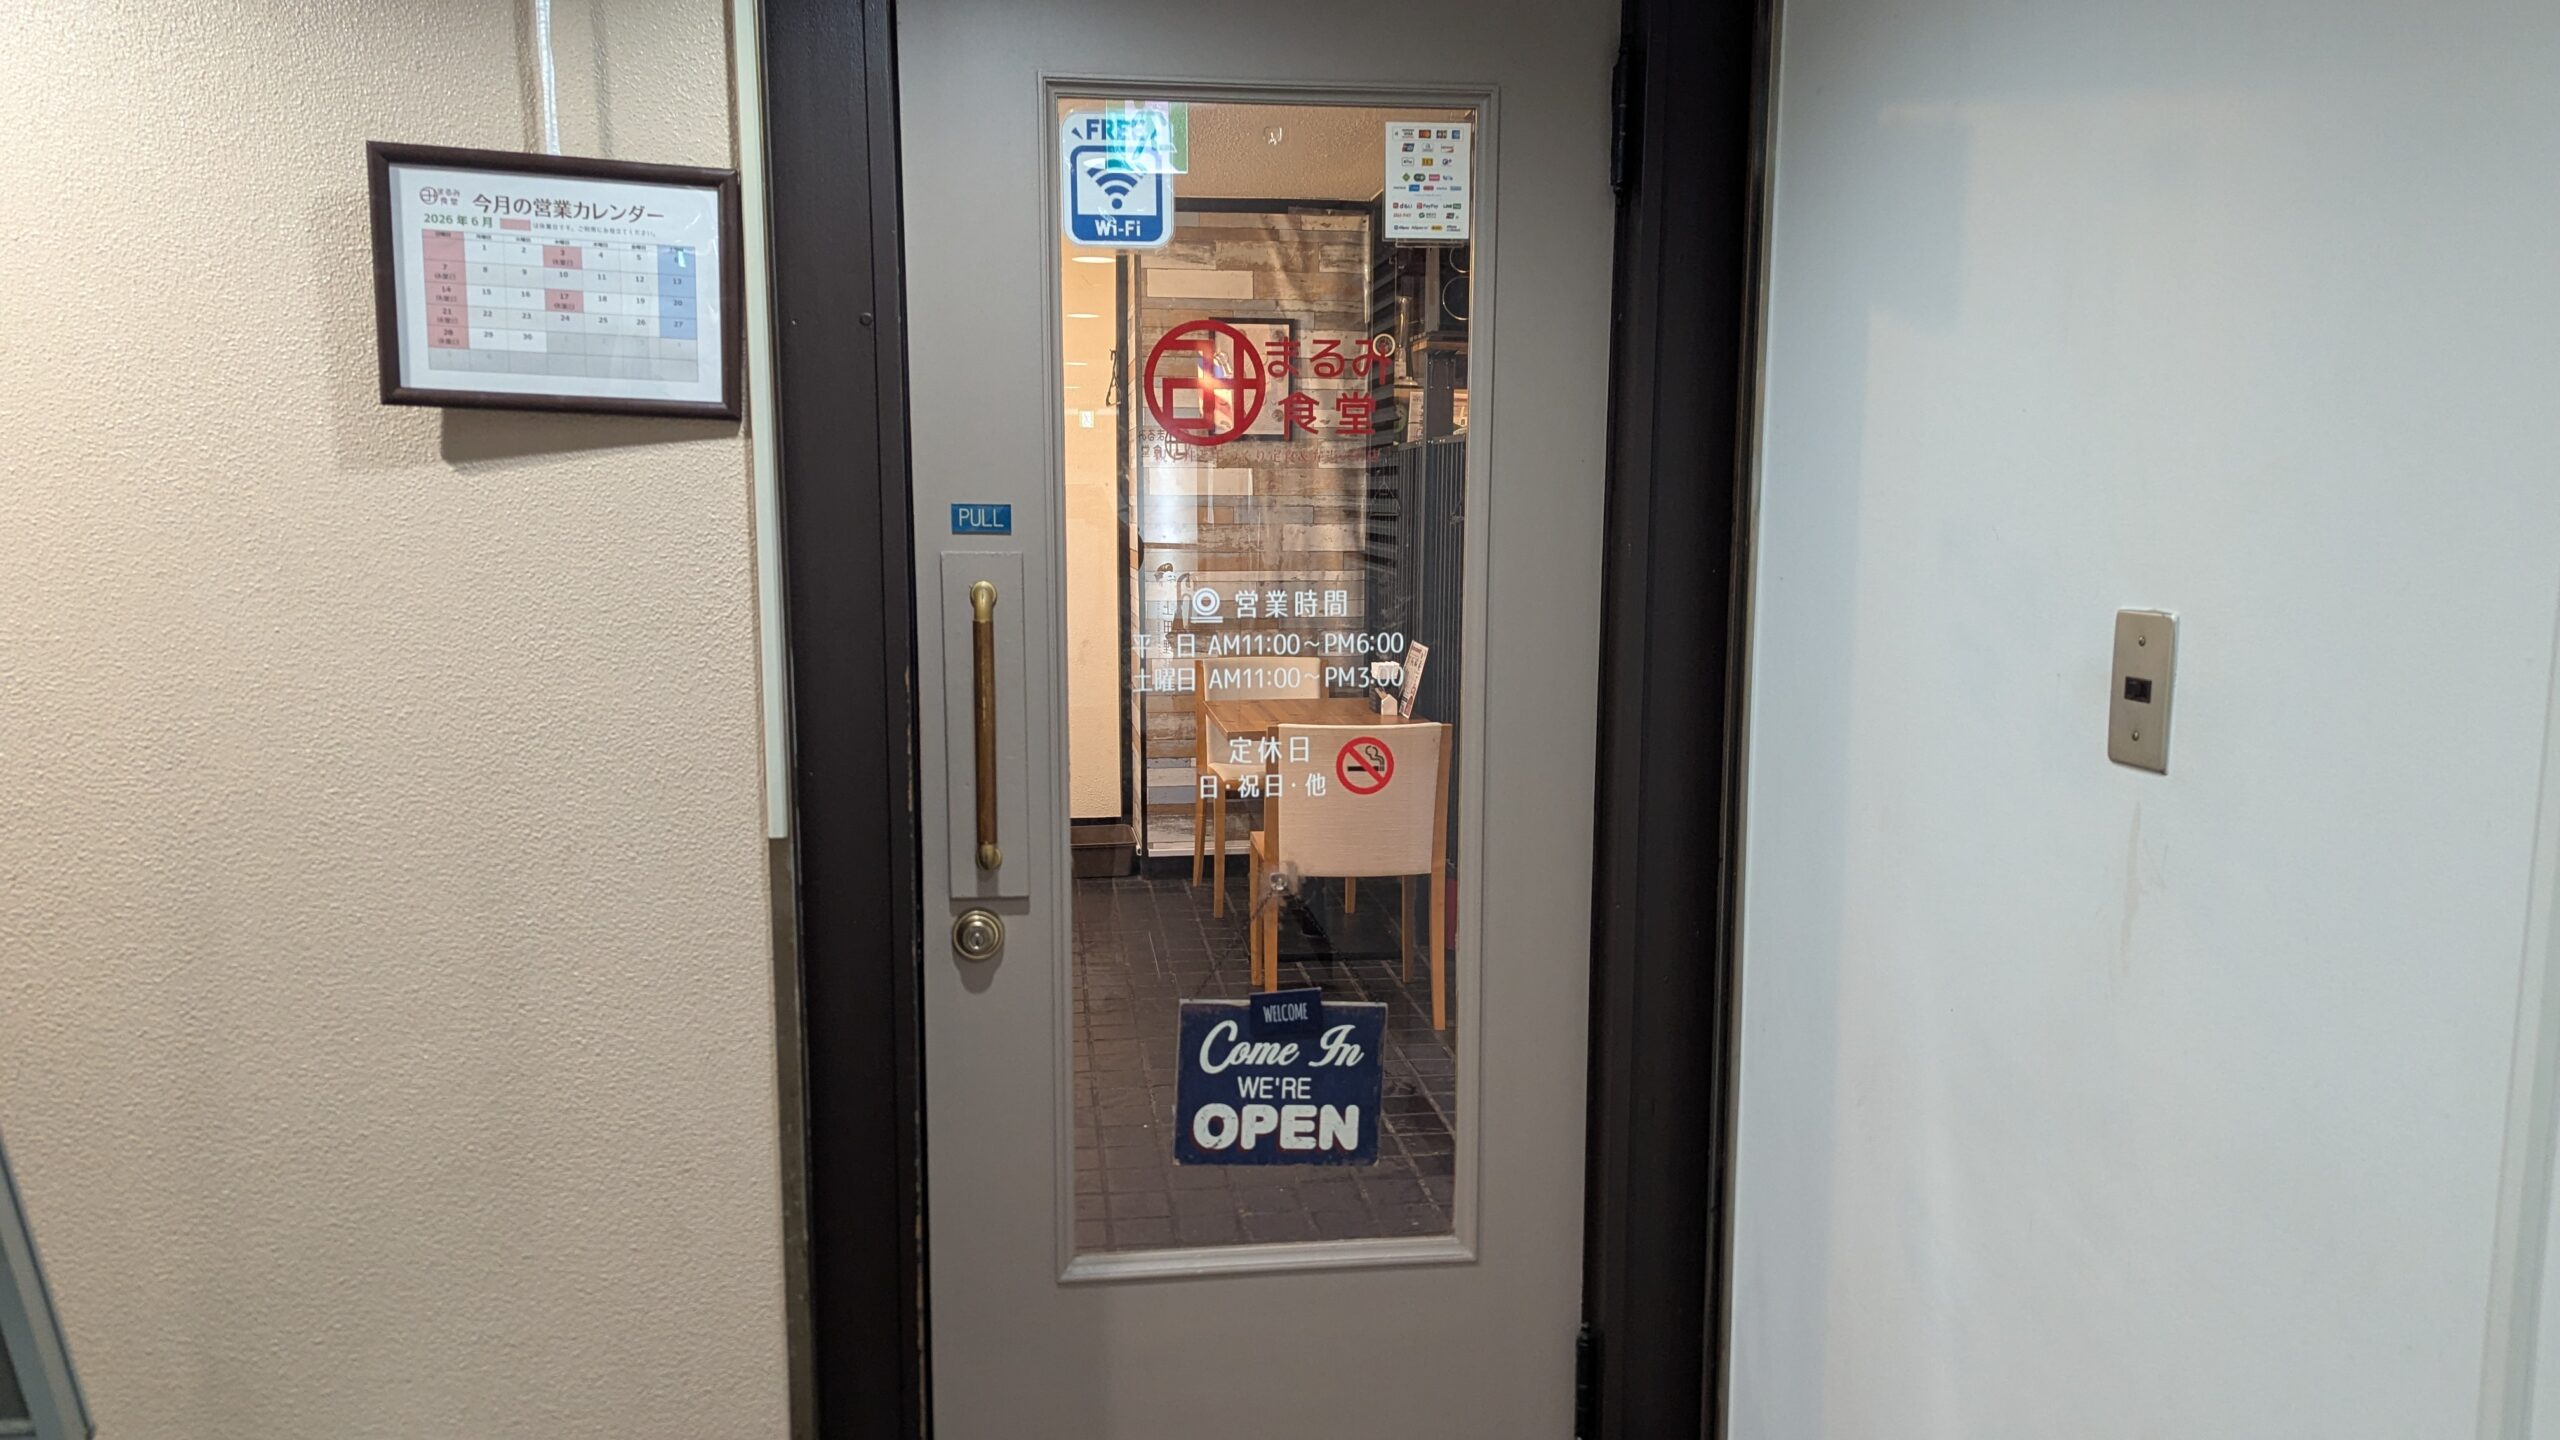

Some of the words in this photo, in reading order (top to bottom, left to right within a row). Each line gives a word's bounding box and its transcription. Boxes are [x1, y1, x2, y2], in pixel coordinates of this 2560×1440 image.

[472, 193, 665, 223] 今月の営業カレンダー
[1095, 219, 1141, 237] Wi-Fi
[1265, 335, 1393, 385] まるみ
[1278, 391, 1377, 441] 食堂
[958, 508, 1005, 528] PULL
[1235, 590, 1348, 618] 営業時間
[1132, 633, 1196, 659] 平日
[1132, 667, 1196, 692] 土曜日
[1229, 736, 1310, 764] 定休日
[1263, 1002, 1309, 1024] WELCOME
[1199, 1019, 1300, 1075] Come
[1308, 1024, 1365, 1067] In
[1237, 1076, 1312, 1100] WE'RE
[1193, 1103, 1361, 1151] OPEN
